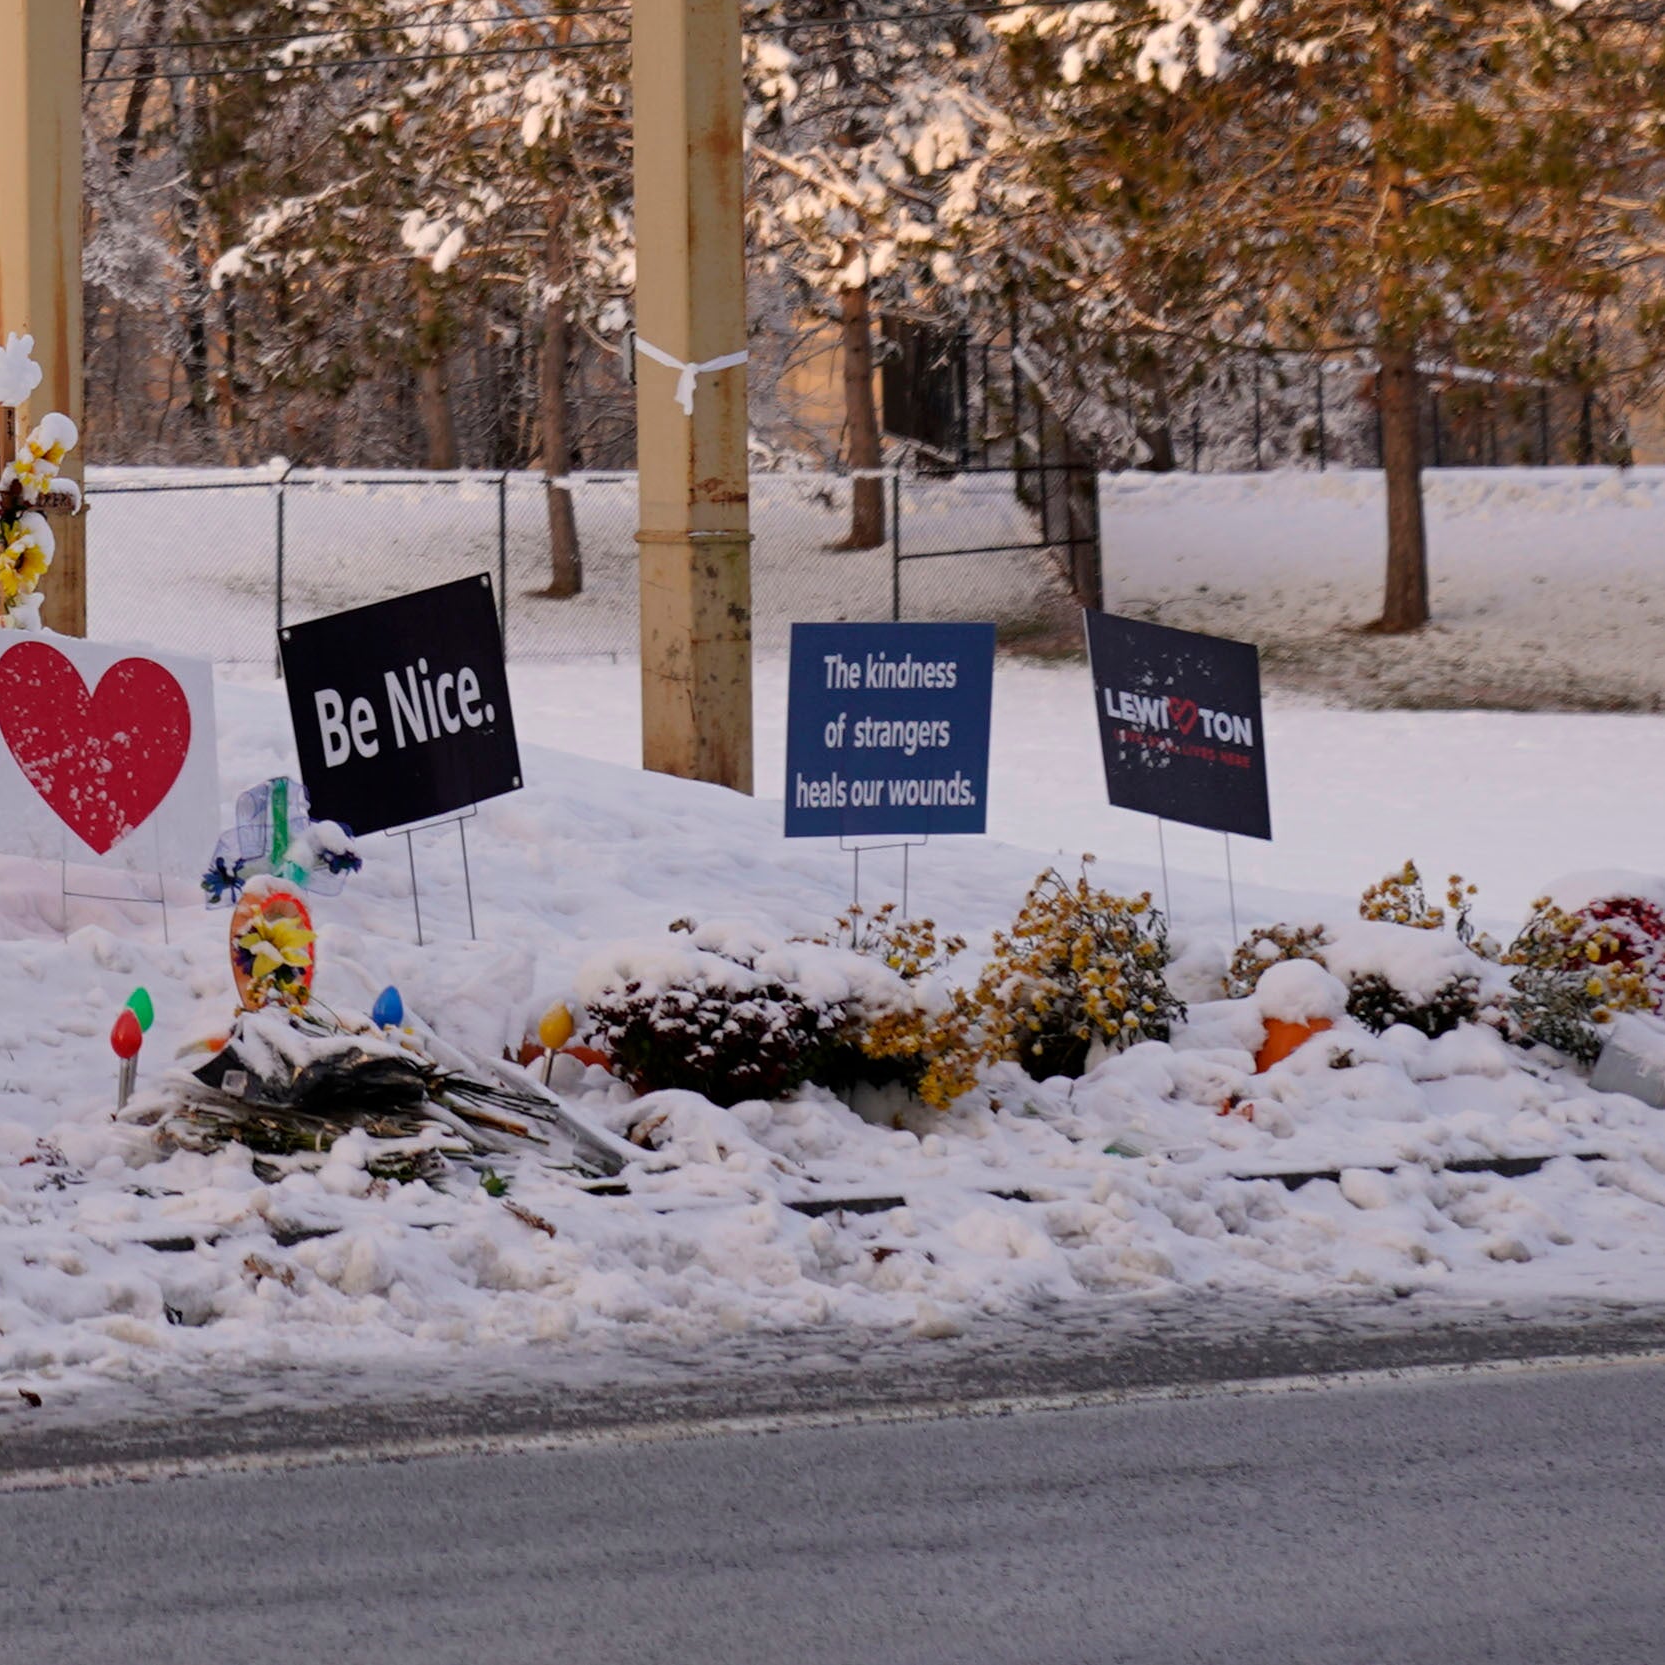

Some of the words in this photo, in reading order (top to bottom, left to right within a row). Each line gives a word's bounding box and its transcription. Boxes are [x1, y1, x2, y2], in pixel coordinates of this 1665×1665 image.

[823, 653, 861, 689] The
[865, 651, 957, 689] kindness
[314, 688, 380, 768] Be
[384, 657, 496, 749] Nice.
[1104, 687, 1253, 747] LEWITON
[824, 712, 847, 748] of
[853, 716, 951, 756] strangers
[1182, 742, 1216, 761] LIVES
[1219, 751, 1252, 769] HERE
[795, 772, 847, 808] heals
[850, 779, 884, 807] our
[887, 770, 976, 806] wounds.
